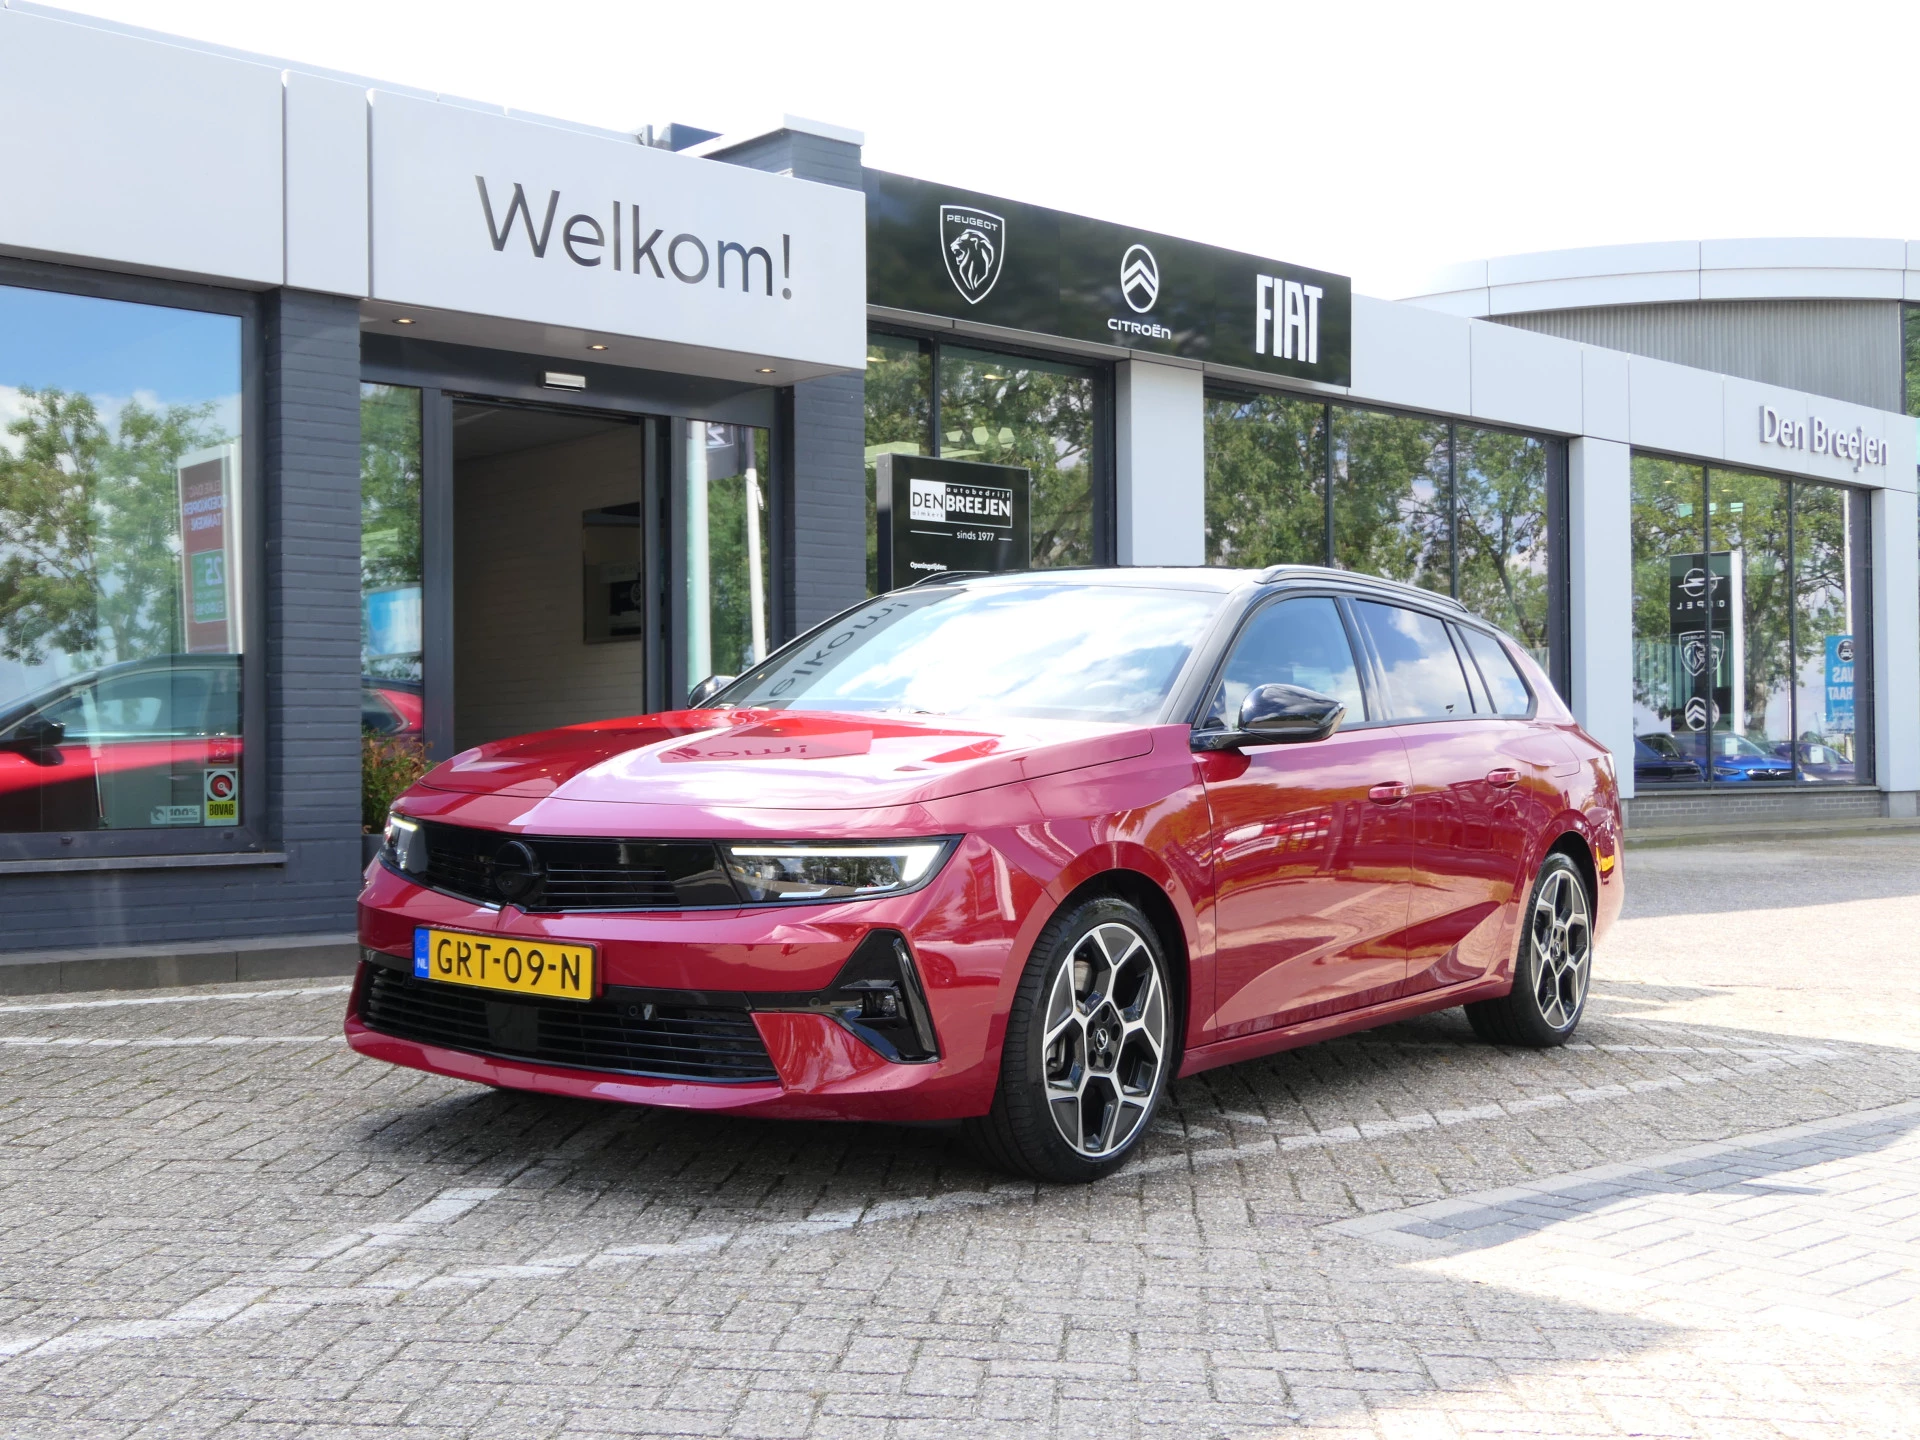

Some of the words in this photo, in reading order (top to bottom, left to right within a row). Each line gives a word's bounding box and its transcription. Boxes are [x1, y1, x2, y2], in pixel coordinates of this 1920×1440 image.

[946, 213, 999, 232] PEUGEOT
[475, 175, 793, 300] Welkom!
[1255, 273, 1323, 364] FIAT
[1759, 405, 1806, 451] Den
[1809, 416, 1889, 473] Breejen
[912, 491, 944, 510] DEN
[946, 494, 1011, 517] BREEJEN
[946, 486, 1010, 499] autobedrijf
[956, 530, 976, 540] sinds
[977, 531, 995, 541] 1977
[209, 803, 234, 816] BOVAG
[416, 957, 428, 970] NL
[437, 938, 581, 991] GRT-09-N
